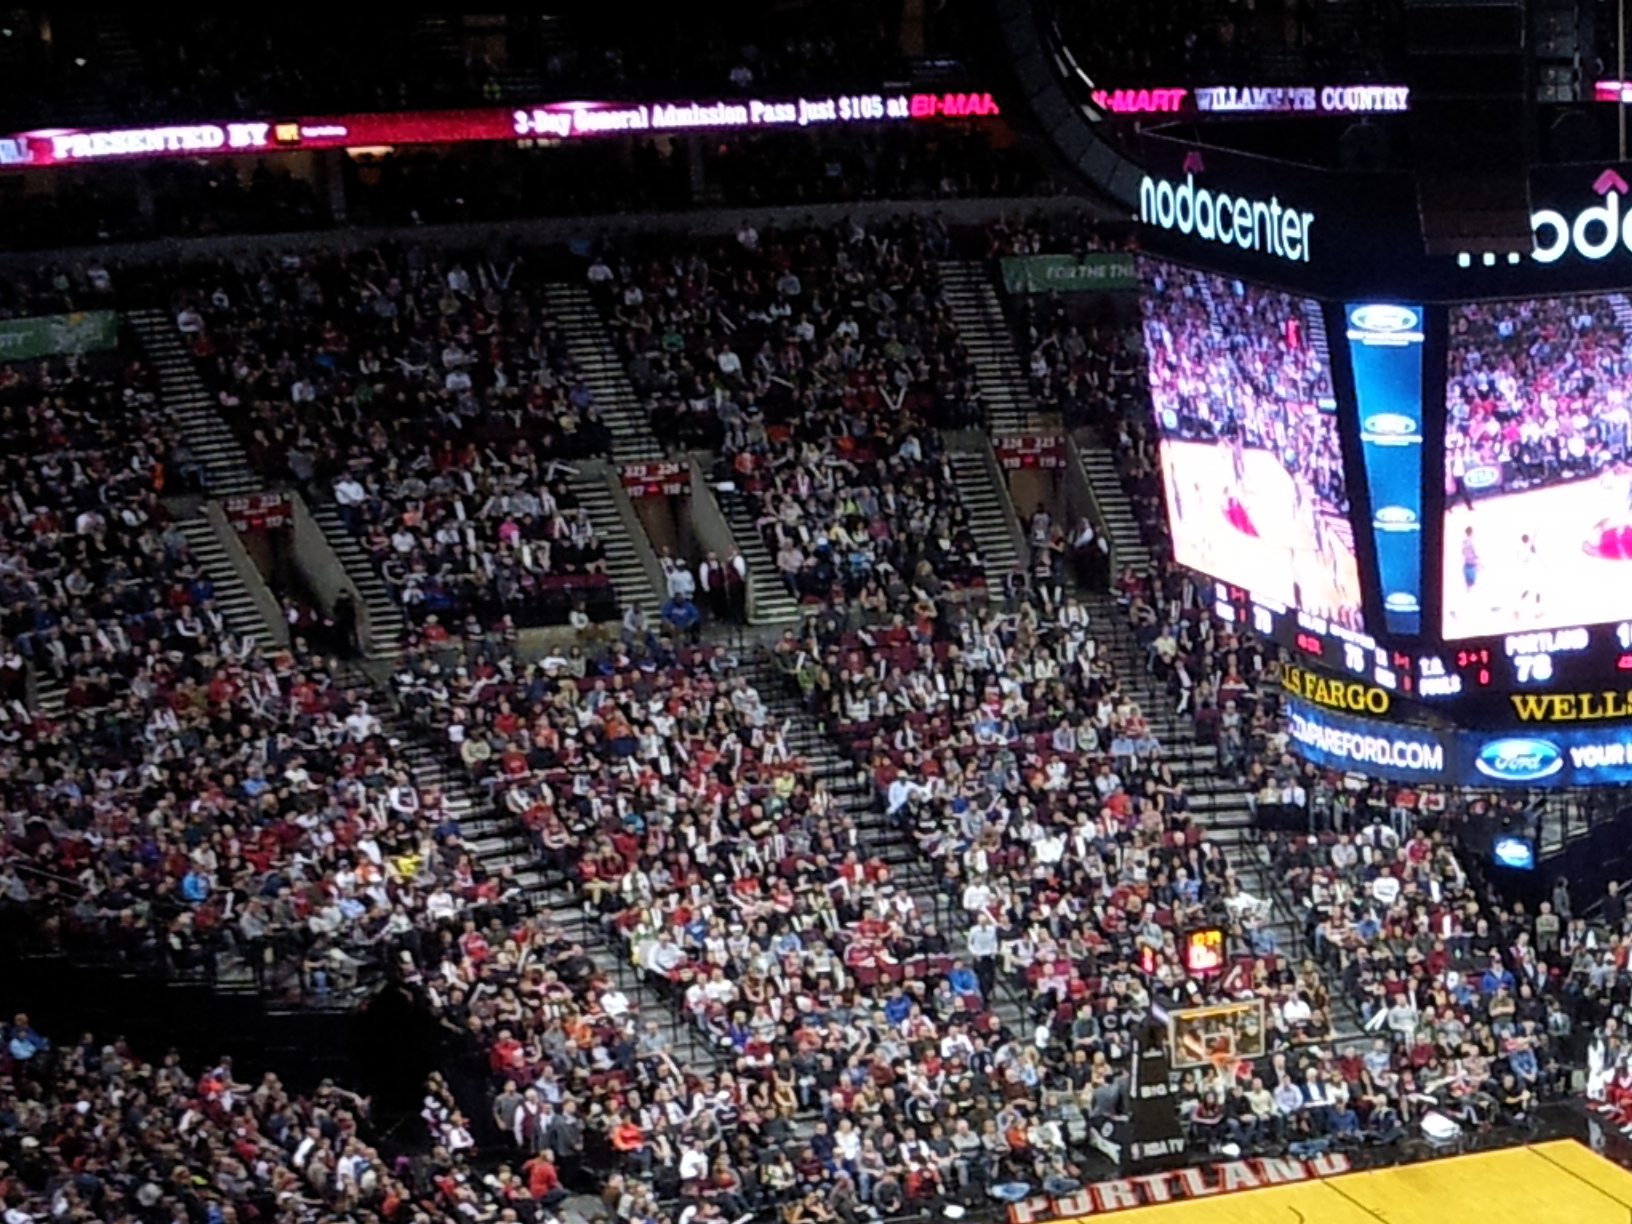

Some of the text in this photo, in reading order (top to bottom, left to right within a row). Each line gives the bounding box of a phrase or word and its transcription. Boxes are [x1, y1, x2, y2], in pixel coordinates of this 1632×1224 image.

[513, 110, 571, 136] 3-Day
[573, 105, 649, 131] General
[651, 102, 748, 127] Admission
[750, 100, 795, 124] Pass
[798, 98, 836, 125] just
[838, 95, 884, 120] $105
[887, 95, 909, 117] at
[1321, 86, 1411, 112] COUNTRY
[53, 125, 224, 158] PRESENTED
[227, 123, 268, 147] BY
[1506, 628, 1588, 655] PORTLAND
[1304, 673, 1390, 714] FARGO
[1570, 744, 1625, 768] YOUR
[1008, 1153, 1351, 1224] PORTLAND
